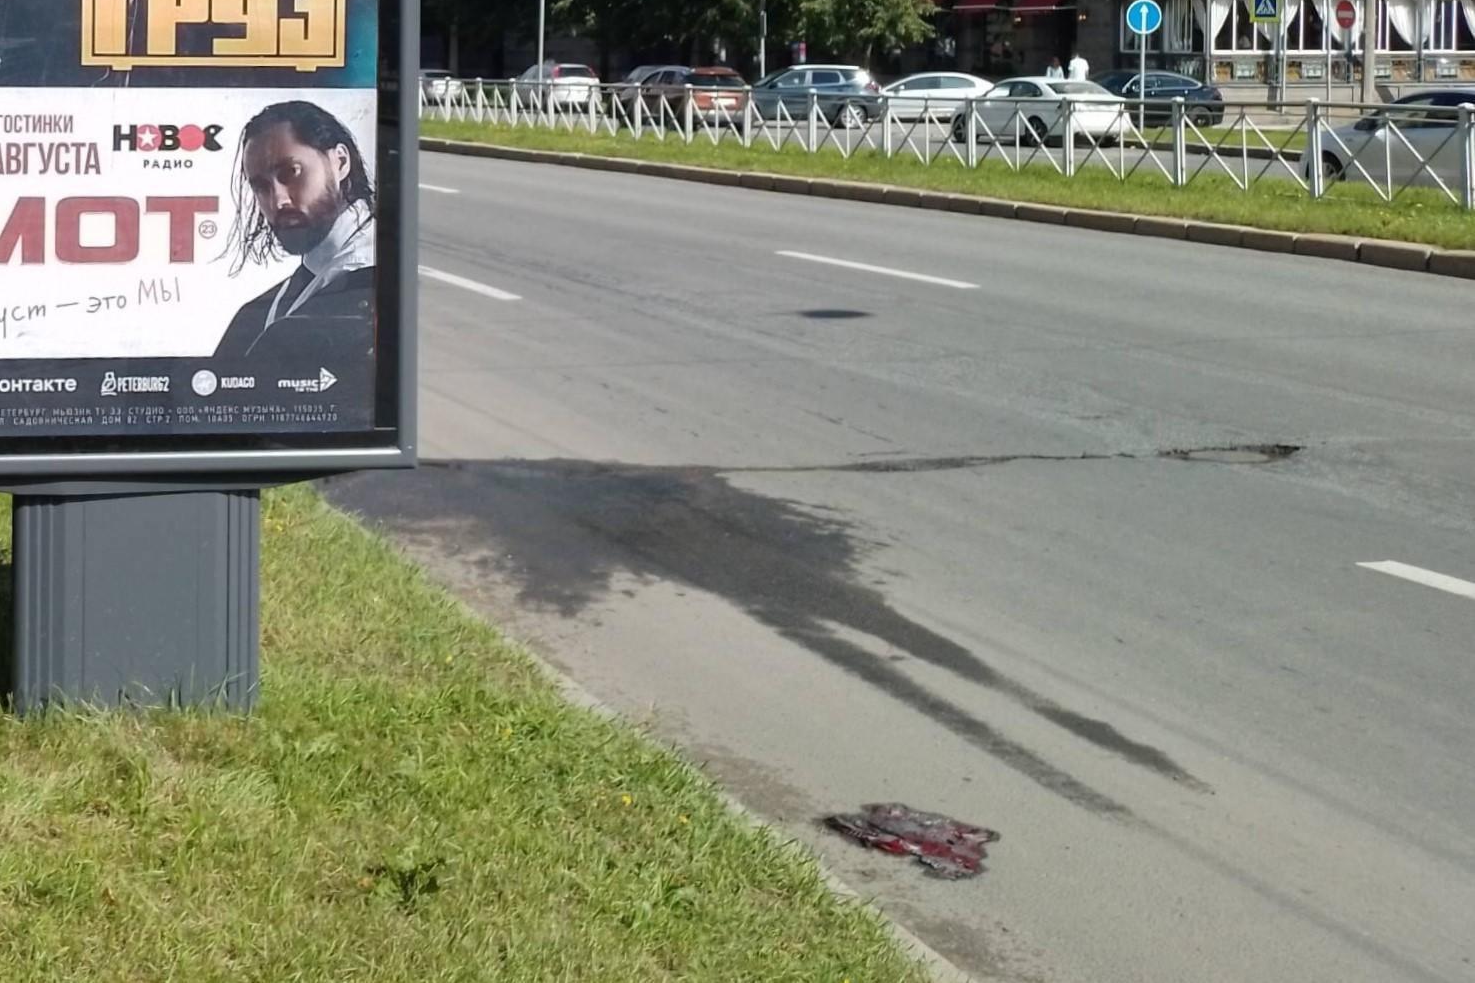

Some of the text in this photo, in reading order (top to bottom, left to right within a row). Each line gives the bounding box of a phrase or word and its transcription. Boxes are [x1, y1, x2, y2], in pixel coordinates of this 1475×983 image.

[143, 159, 194, 170] РАДИО
[86, 295, 127, 314] это
[137, 276, 181, 305] МЫ
